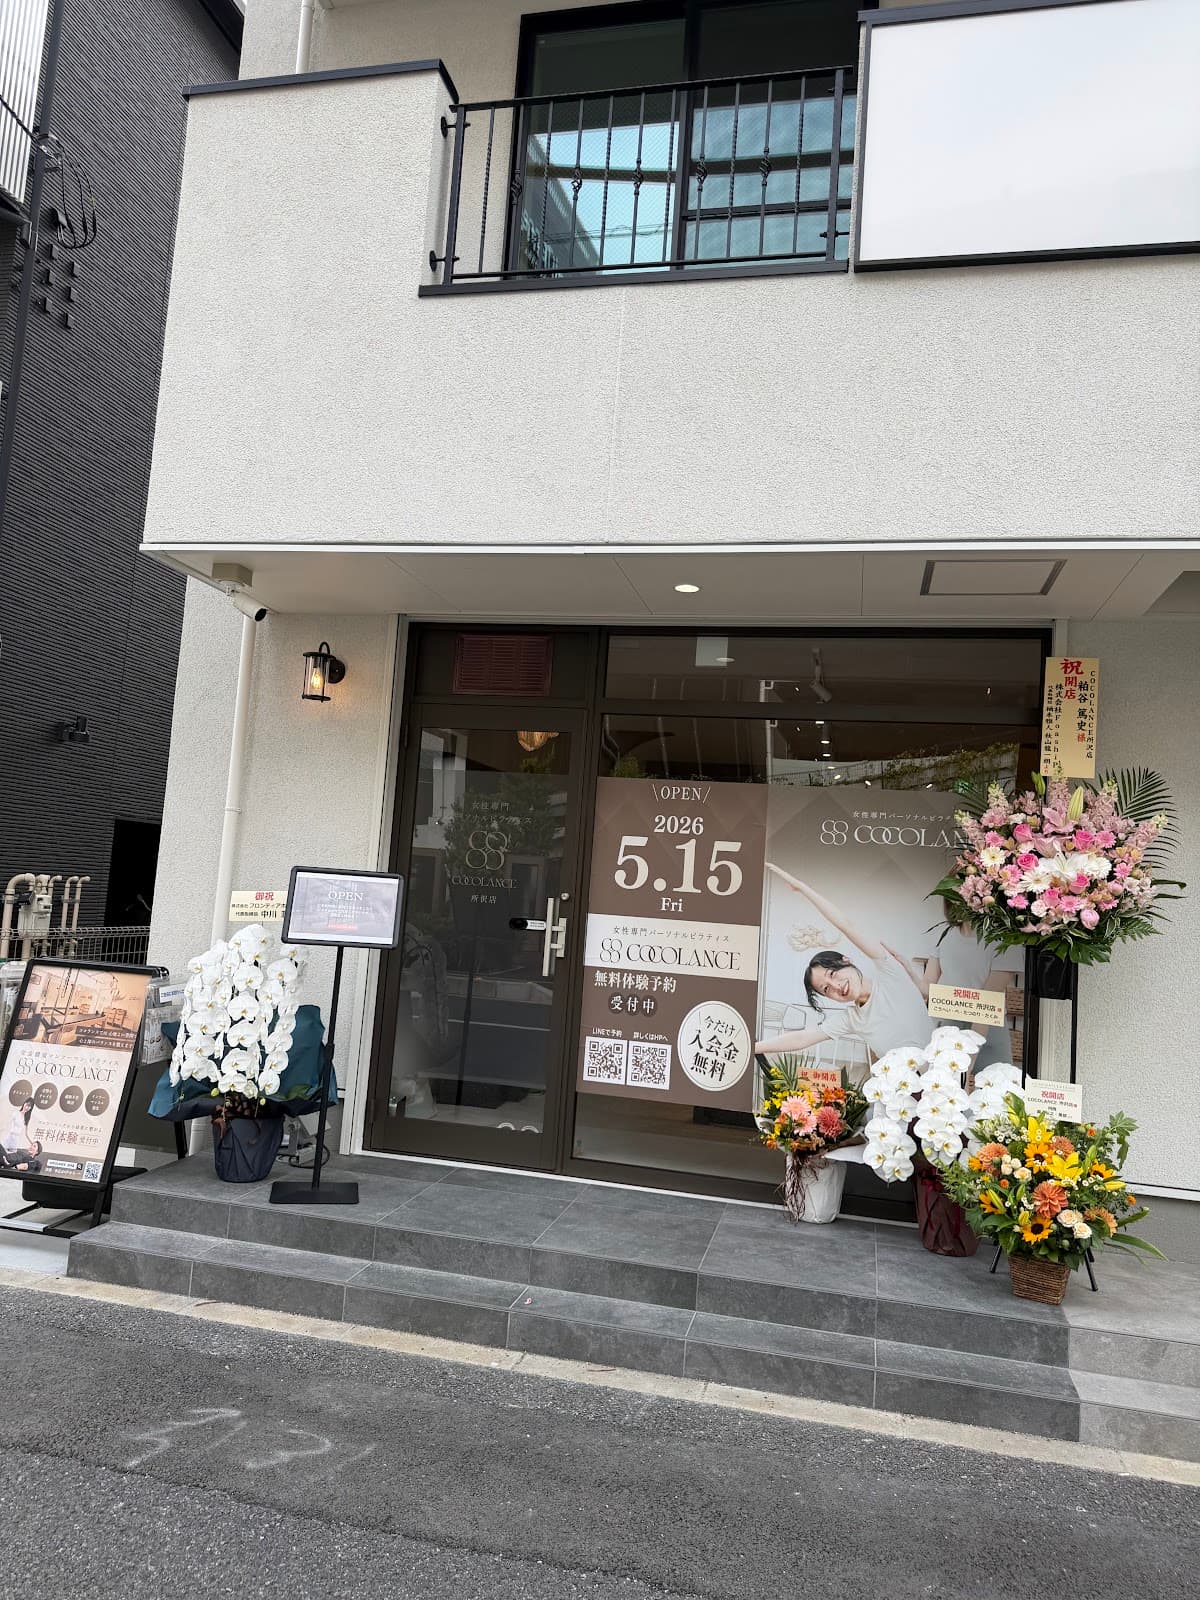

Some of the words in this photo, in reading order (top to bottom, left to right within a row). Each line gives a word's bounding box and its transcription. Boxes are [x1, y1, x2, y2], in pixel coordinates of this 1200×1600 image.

[1060, 658, 1084, 700] 祝開店
[660, 786, 702, 801] OPEN
[653, 814, 704, 836] 2026
[614, 835, 743, 897] 5.15
[452, 875, 518, 889] COCOLANCE
[255, 891, 274, 901] 御祝
[328, 891, 364, 902] OPEN
[471, 894, 497, 905] 所沢店
[660, 897, 684, 912] Fri
[261, 910, 277, 919] 中川
[613, 925, 730, 943] 女性専門パーソナルピラティス
[626, 943, 741, 971] COCOLANCE
[594, 970, 678, 993] 無料体験予約
[931, 997, 974, 1010] COCOLANCE
[953, 988, 981, 1001] 祝開店
[610, 995, 656, 1014] 受付中
[592, 1027, 623, 1038] LINEで予約
[704, 1015, 736, 1035] 今だけ
[688, 1029, 740, 1064] 入会金
[35, 1061, 117, 1082] COCOLANCE
[690, 1052, 726, 1082] 無料
[1041, 1090, 1065, 1101] 祝開店
[33, 1127, 79, 1145] 無料体験
